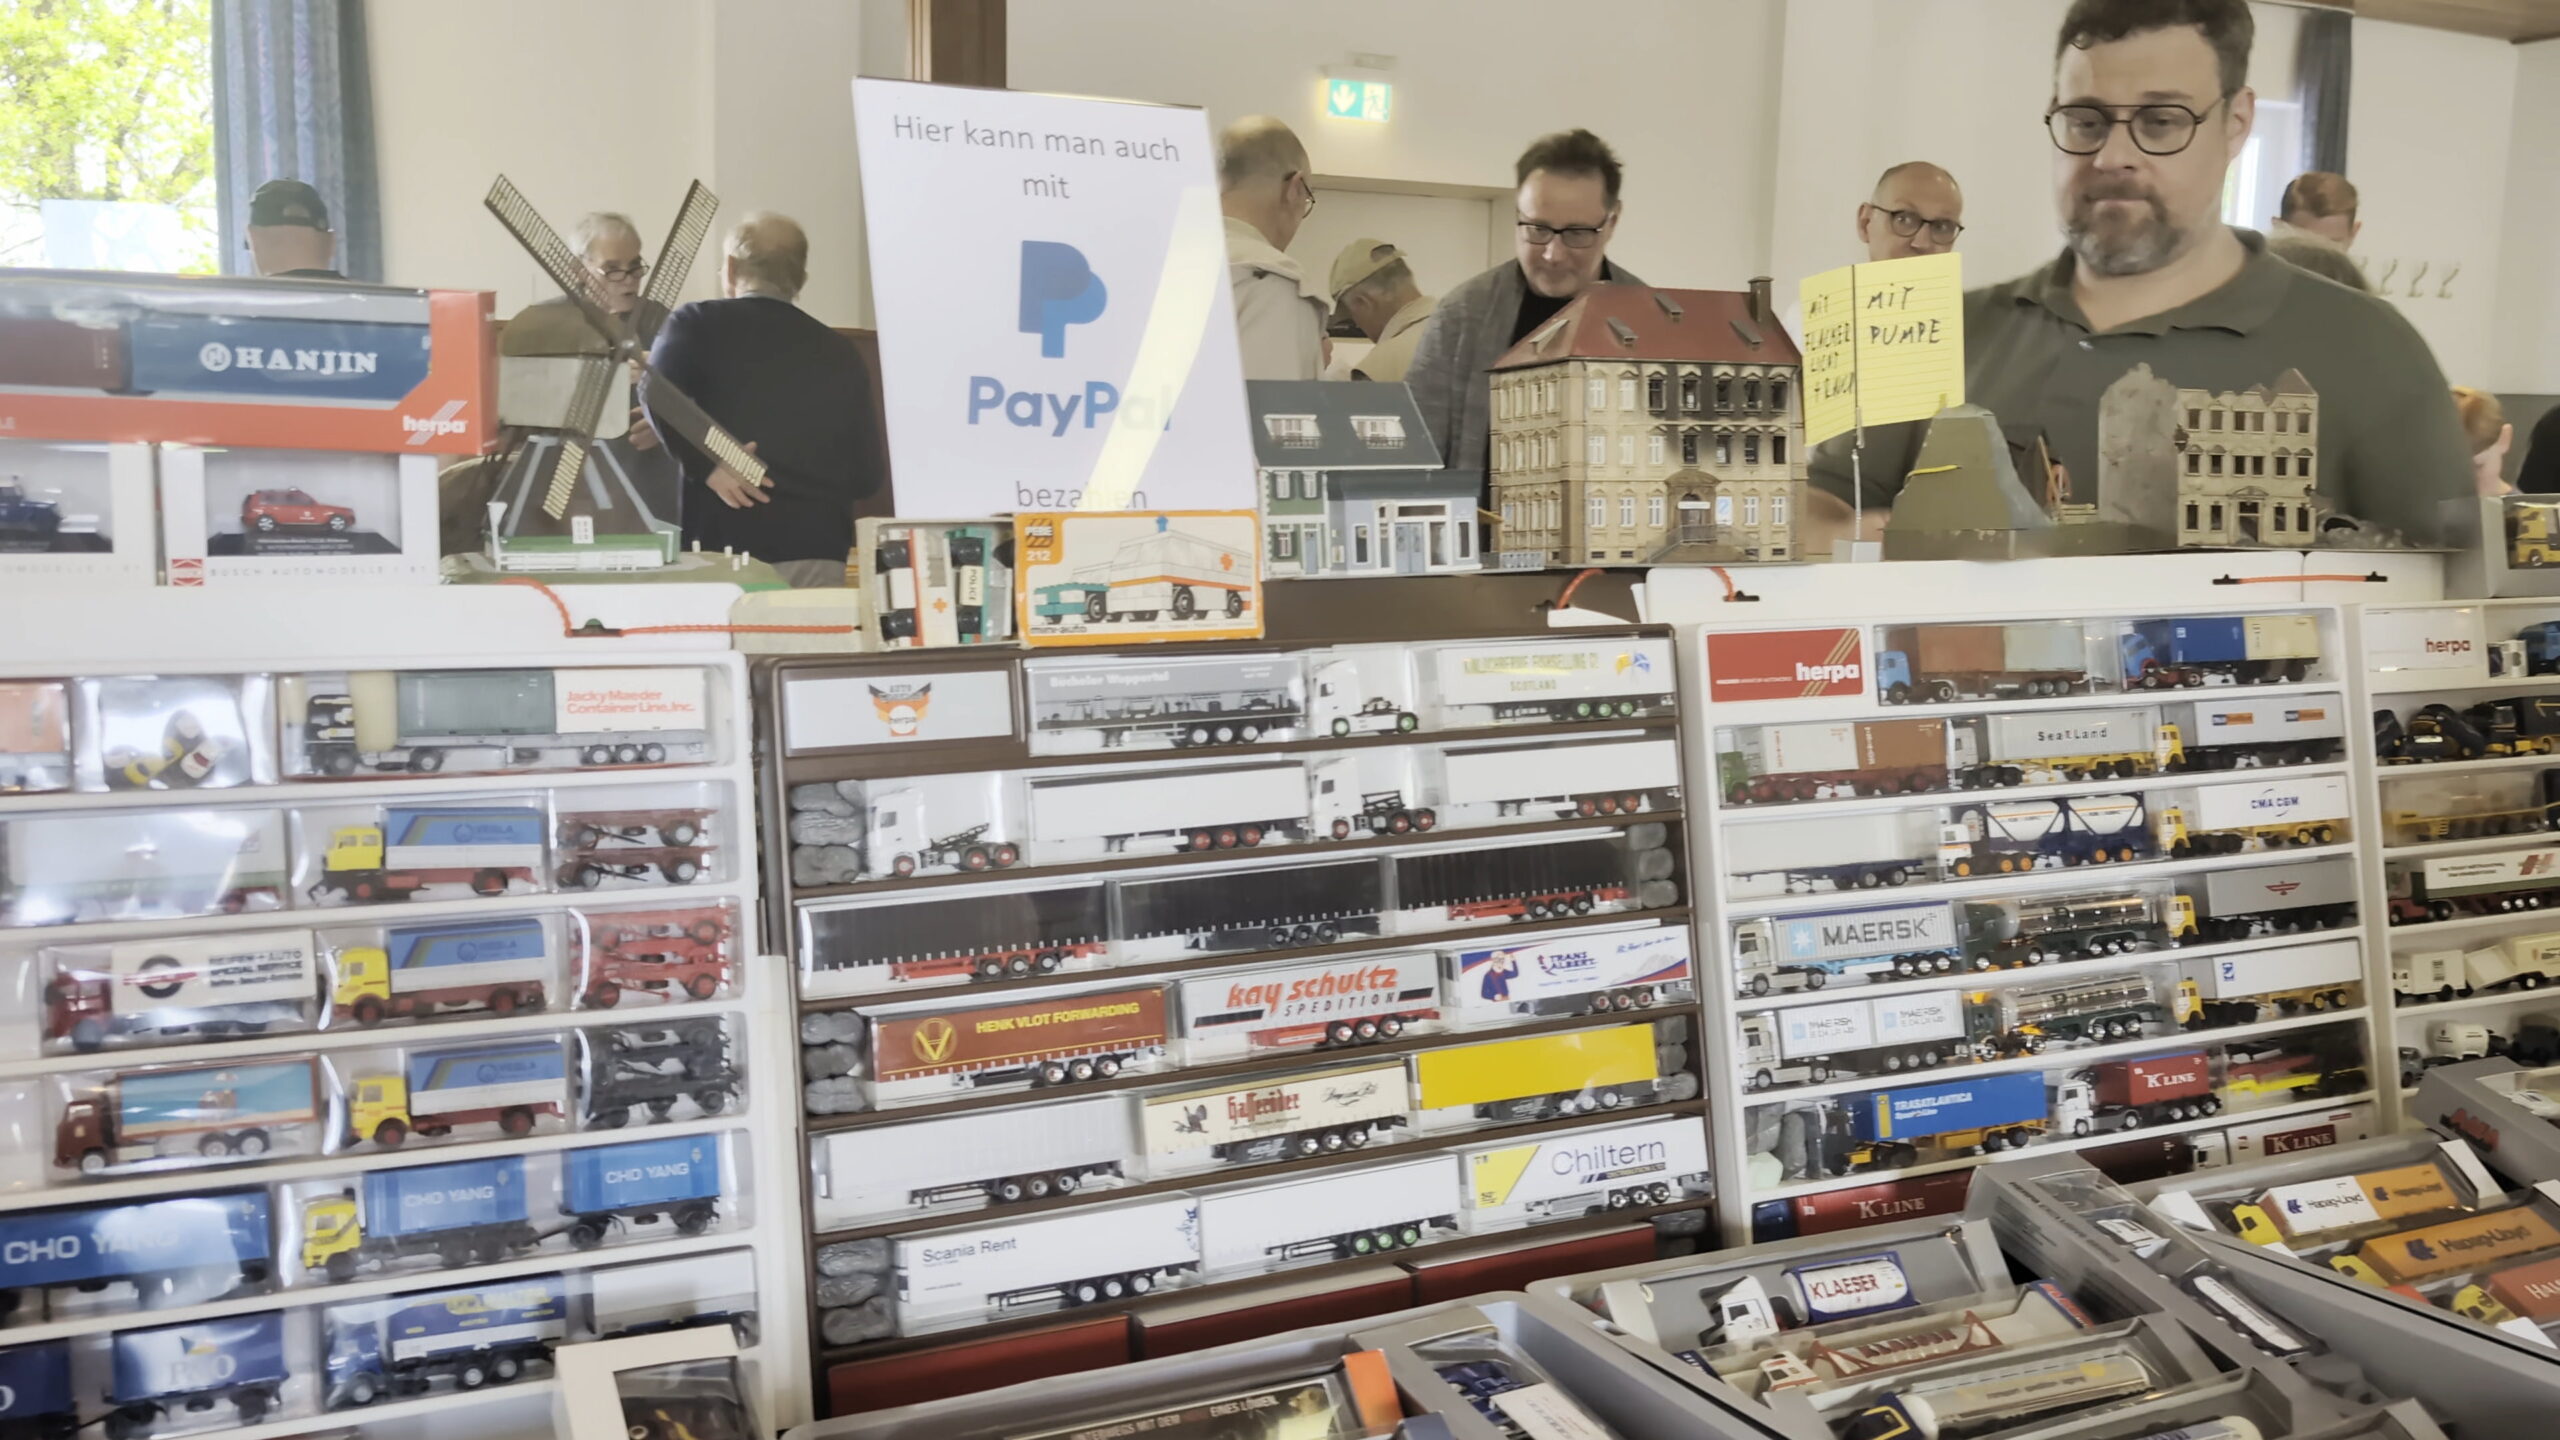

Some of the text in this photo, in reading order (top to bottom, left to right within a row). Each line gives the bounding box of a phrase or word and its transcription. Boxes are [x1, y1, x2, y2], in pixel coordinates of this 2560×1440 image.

[893, 114, 1180, 163] Hier kann man auch
[1023, 174, 1070, 199] mit
[1870, 318, 1941, 345] PUMPE
[236, 346, 378, 374] HANJIN
[402, 414, 466, 435] herpa
[1016, 481, 1147, 509] bezaen
[1026, 550, 1051, 561] 212
[2425, 638, 2471, 656] herpa
[1796, 662, 1860, 684] herpa
[566, 703, 637, 714] Container
[1822, 917, 1930, 947] MAERSK
[1549, 951, 1587, 963] TRANS
[1287, 965, 1398, 1000] schultz
[1284, 992, 1394, 1017] SPEDITION
[976, 1002, 1140, 1033] HENK VLOT FORWARDING
[2163, 1072, 2197, 1086] LINE
[2293, 1133, 2331, 1149] LINE
[1552, 1140, 1666, 1176] Chiltern
[606, 1162, 689, 1184] CHO YANG
[404, 1185, 495, 1207] CHO YANG
[1883, 1197, 1926, 1216] LINE
[4, 1235, 80, 1264] CHO
[923, 1245, 976, 1263] Scania
[981, 1238, 1016, 1254] Rent
[1808, 1274, 1880, 1299] KLAESER
[170, 1354, 237, 1384] PO
